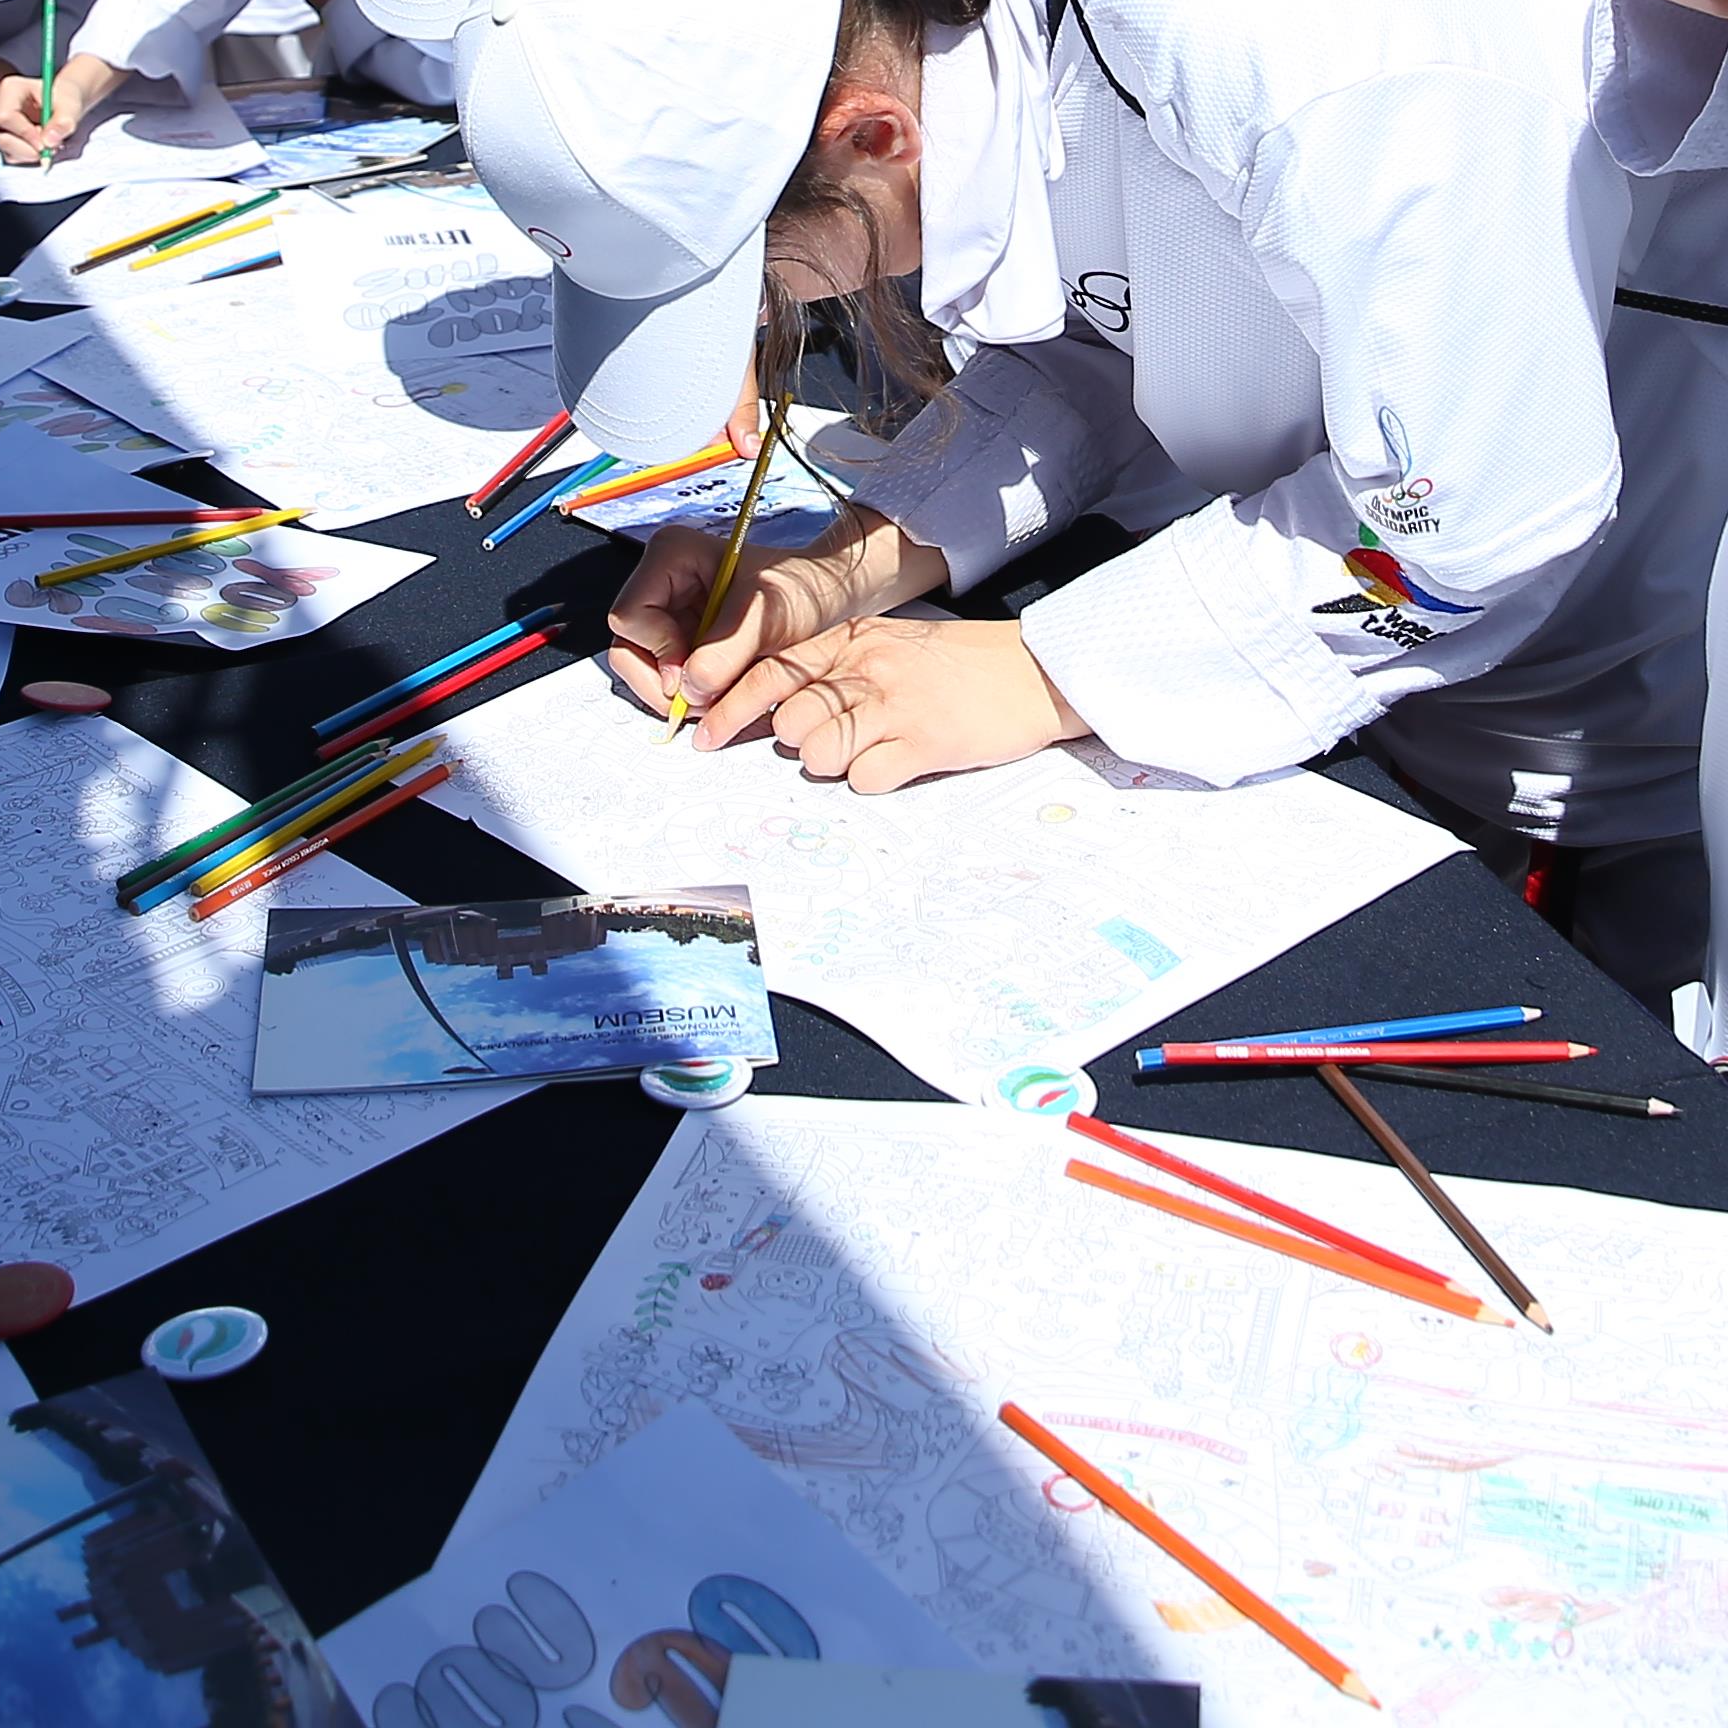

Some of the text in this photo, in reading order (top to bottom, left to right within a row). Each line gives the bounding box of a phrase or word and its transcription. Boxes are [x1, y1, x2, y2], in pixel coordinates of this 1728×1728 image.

[1365, 503, 1441, 536] SOLIDARITY
[1371, 494, 1430, 523] OLYMPIC
[593, 1004, 737, 1030] MUSEUM
[671, 1021, 741, 1033] NATIONAL
